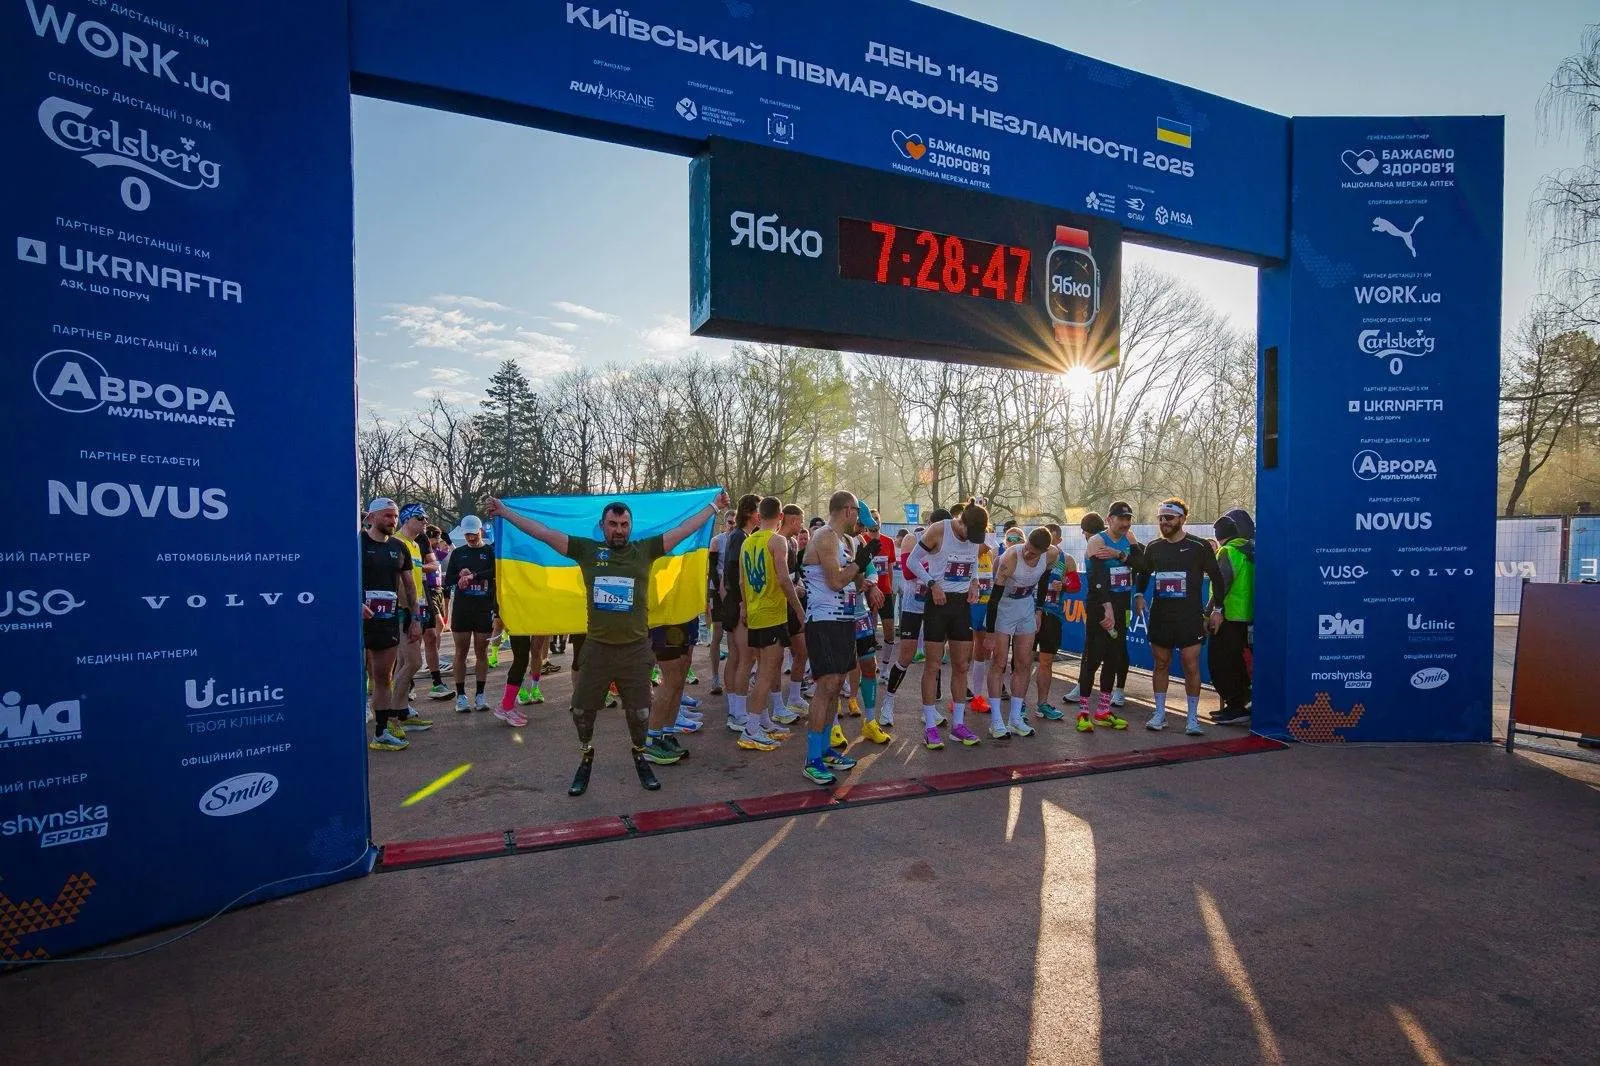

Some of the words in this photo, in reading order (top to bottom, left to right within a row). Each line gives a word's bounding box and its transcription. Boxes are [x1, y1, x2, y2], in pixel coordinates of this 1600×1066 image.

[111, 3, 175, 34] ДИСТАНЦІЇ
[178, 28, 189, 39] 21
[193, 34, 209, 48] КМ
[25, 0, 231, 101] WORK.ua
[865, 41, 942, 77] ДЕНЬ
[947, 64, 999, 93] 1145
[48, 71, 109, 96] СПОНСОР
[112, 92, 177, 119] ДИСТАНЦІЇ
[181, 113, 193, 125] 10
[195, 118, 212, 131] КМ
[566, 3, 767, 71] КИЇВСЬКИЙ
[776, 56, 965, 121] ПІВМАРАФОН
[972, 106, 1138, 164] НЕЗЛАМНОСТІ
[1143, 151, 1195, 178] 2025
[38, 96, 221, 189] Carlsberg
[928, 137, 991, 161] БАЖАЄМО
[1382, 149, 1455, 160] БАЖАЄМО
[892, 162, 940, 178] НАЦІОНАЛЬНА
[941, 172, 968, 185] МЕРЕЖА
[969, 179, 990, 189] АПТЕК
[120, 176, 150, 211] 0
[1170, 211, 1193, 225] MSA
[56, 217, 114, 237] ПАРТНЕР
[117, 231, 182, 253] ДИСТАНЦІЇ
[185, 246, 191, 255] 5
[194, 248, 210, 259] КМ
[730, 210, 823, 258] Ябко
[59, 245, 242, 303] UKRNAFTA
[871, 222, 1032, 304] 7:28:47
[60, 278, 87, 292] АЗК,
[90, 283, 110, 295] ЩО
[113, 288, 150, 302] ПОРУЧ
[1052, 275, 1092, 299] Ябко
[1354, 286, 1441, 304] WORK.ua
[53, 324, 111, 341] ПАРТНЕР
[115, 334, 179, 352] ДИСТАНЦІЇ
[200, 347, 217, 358] КМ
[1358, 330, 1435, 358] Carlsberg
[1389, 358, 1403, 375] 0
[108, 405, 235, 428] МУЛЬТИМАРКЕТ
[1364, 399, 1444, 412] UKRNAFTA
[80, 450, 136, 462] ПАРТНЕР
[140, 455, 200, 467] ЕСТАФЕТИ
[48, 479, 229, 520] NOVUS
[1356, 512, 1432, 531] NOVUS
[30, 552, 91, 562] ПАРТНЕР
[156, 552, 252, 562] АВТОМОБІЛЬНИЙ
[254, 553, 301, 562] ПАРТНЕР
[1392, 568, 1474, 577] VOLVO
[142, 591, 315, 609] VOLVO
[377, 605, 386, 613] 91
[1407, 613, 1455, 630] Uclinic
[76, 653, 134, 665] МЕДИЧНІ
[137, 649, 198, 662] ПАРТНЕРИ
[1311, 670, 1372, 682] morshynska
[1413, 673, 1447, 686] Smile
[185, 678, 285, 708] Uclinic
[188, 719, 226, 733] ТВОЯ
[230, 712, 285, 728] КЛІНІКА
[182, 749, 243, 766] ОФІЦІЙНИЙ
[246, 743, 292, 757] ПАРТНЕР
[28, 773, 88, 790] ПАРТНЕР
[205, 776, 274, 811] Smile
[43, 824, 105, 845] SPORT
